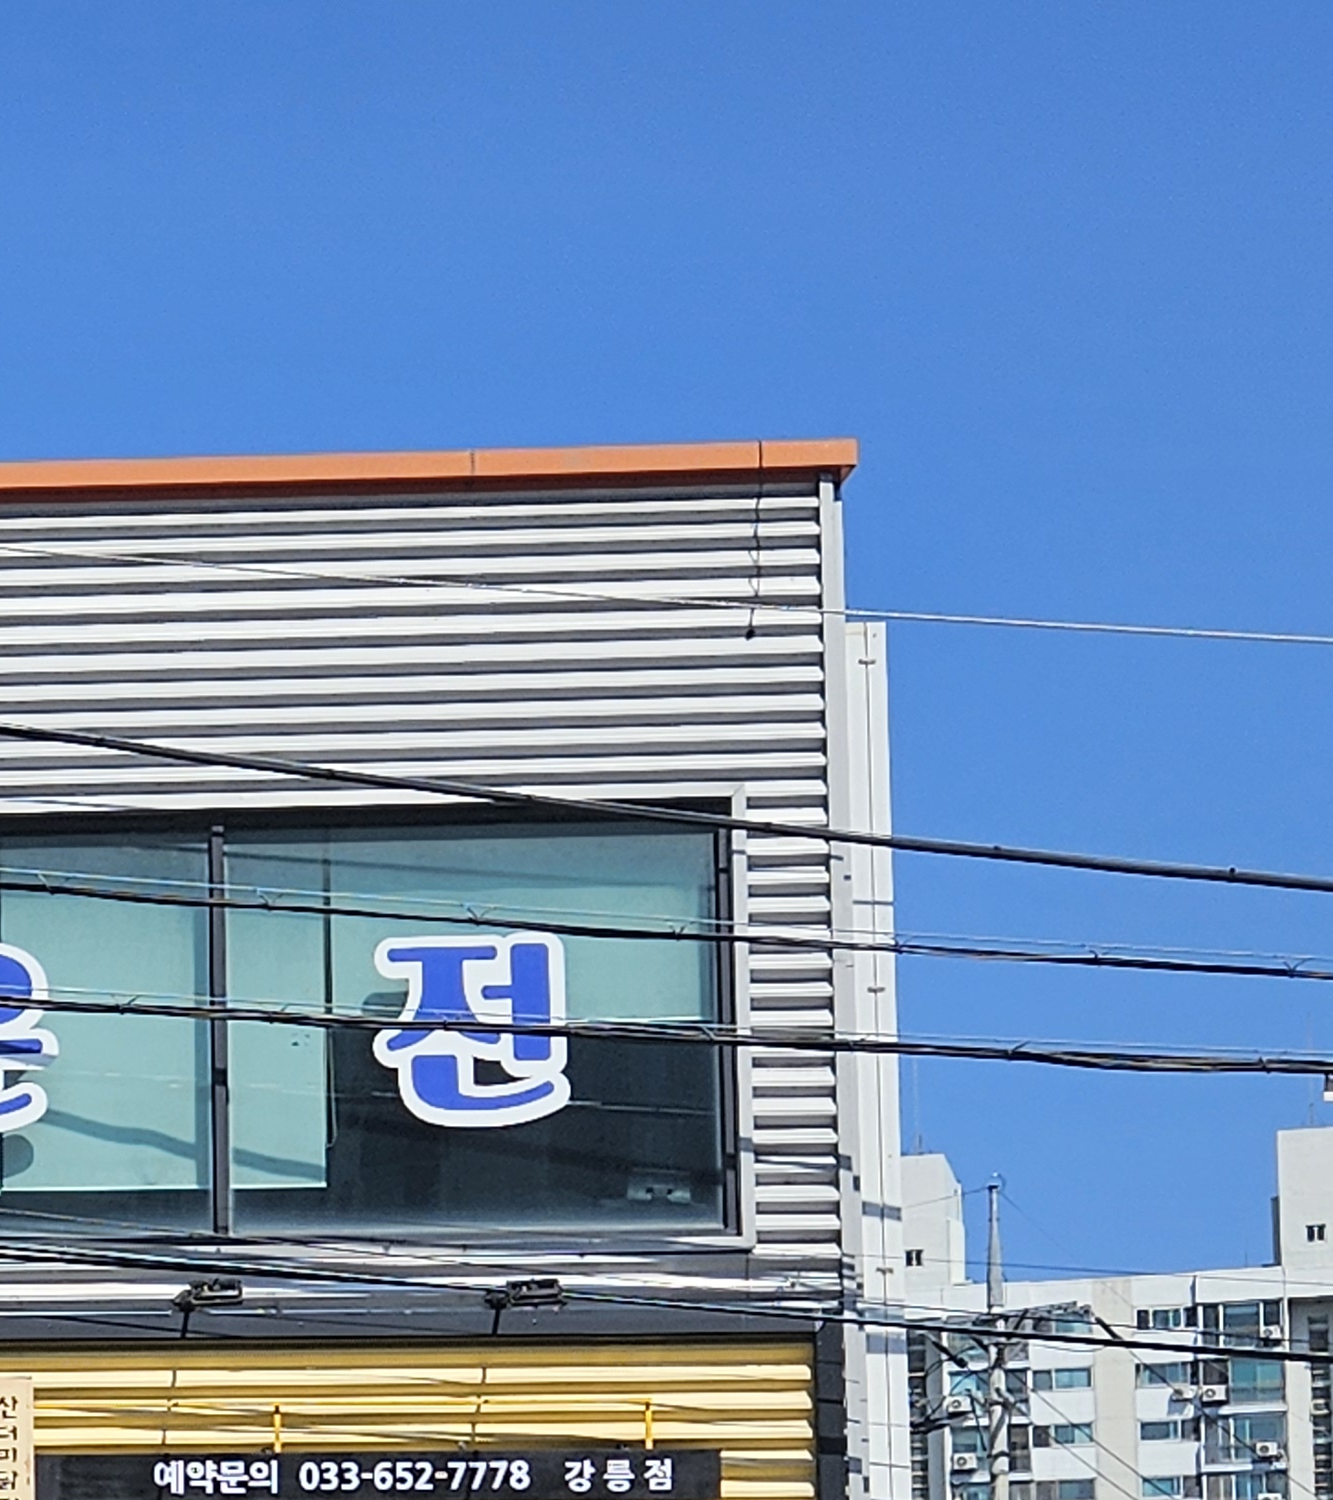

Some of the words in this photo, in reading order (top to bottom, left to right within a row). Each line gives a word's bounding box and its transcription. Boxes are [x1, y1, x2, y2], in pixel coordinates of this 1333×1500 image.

[152, 1458, 280, 1495] 예약문의
[298, 1459, 532, 1491] 033-652-7778
[562, 1458, 675, 1494] 강릉점
